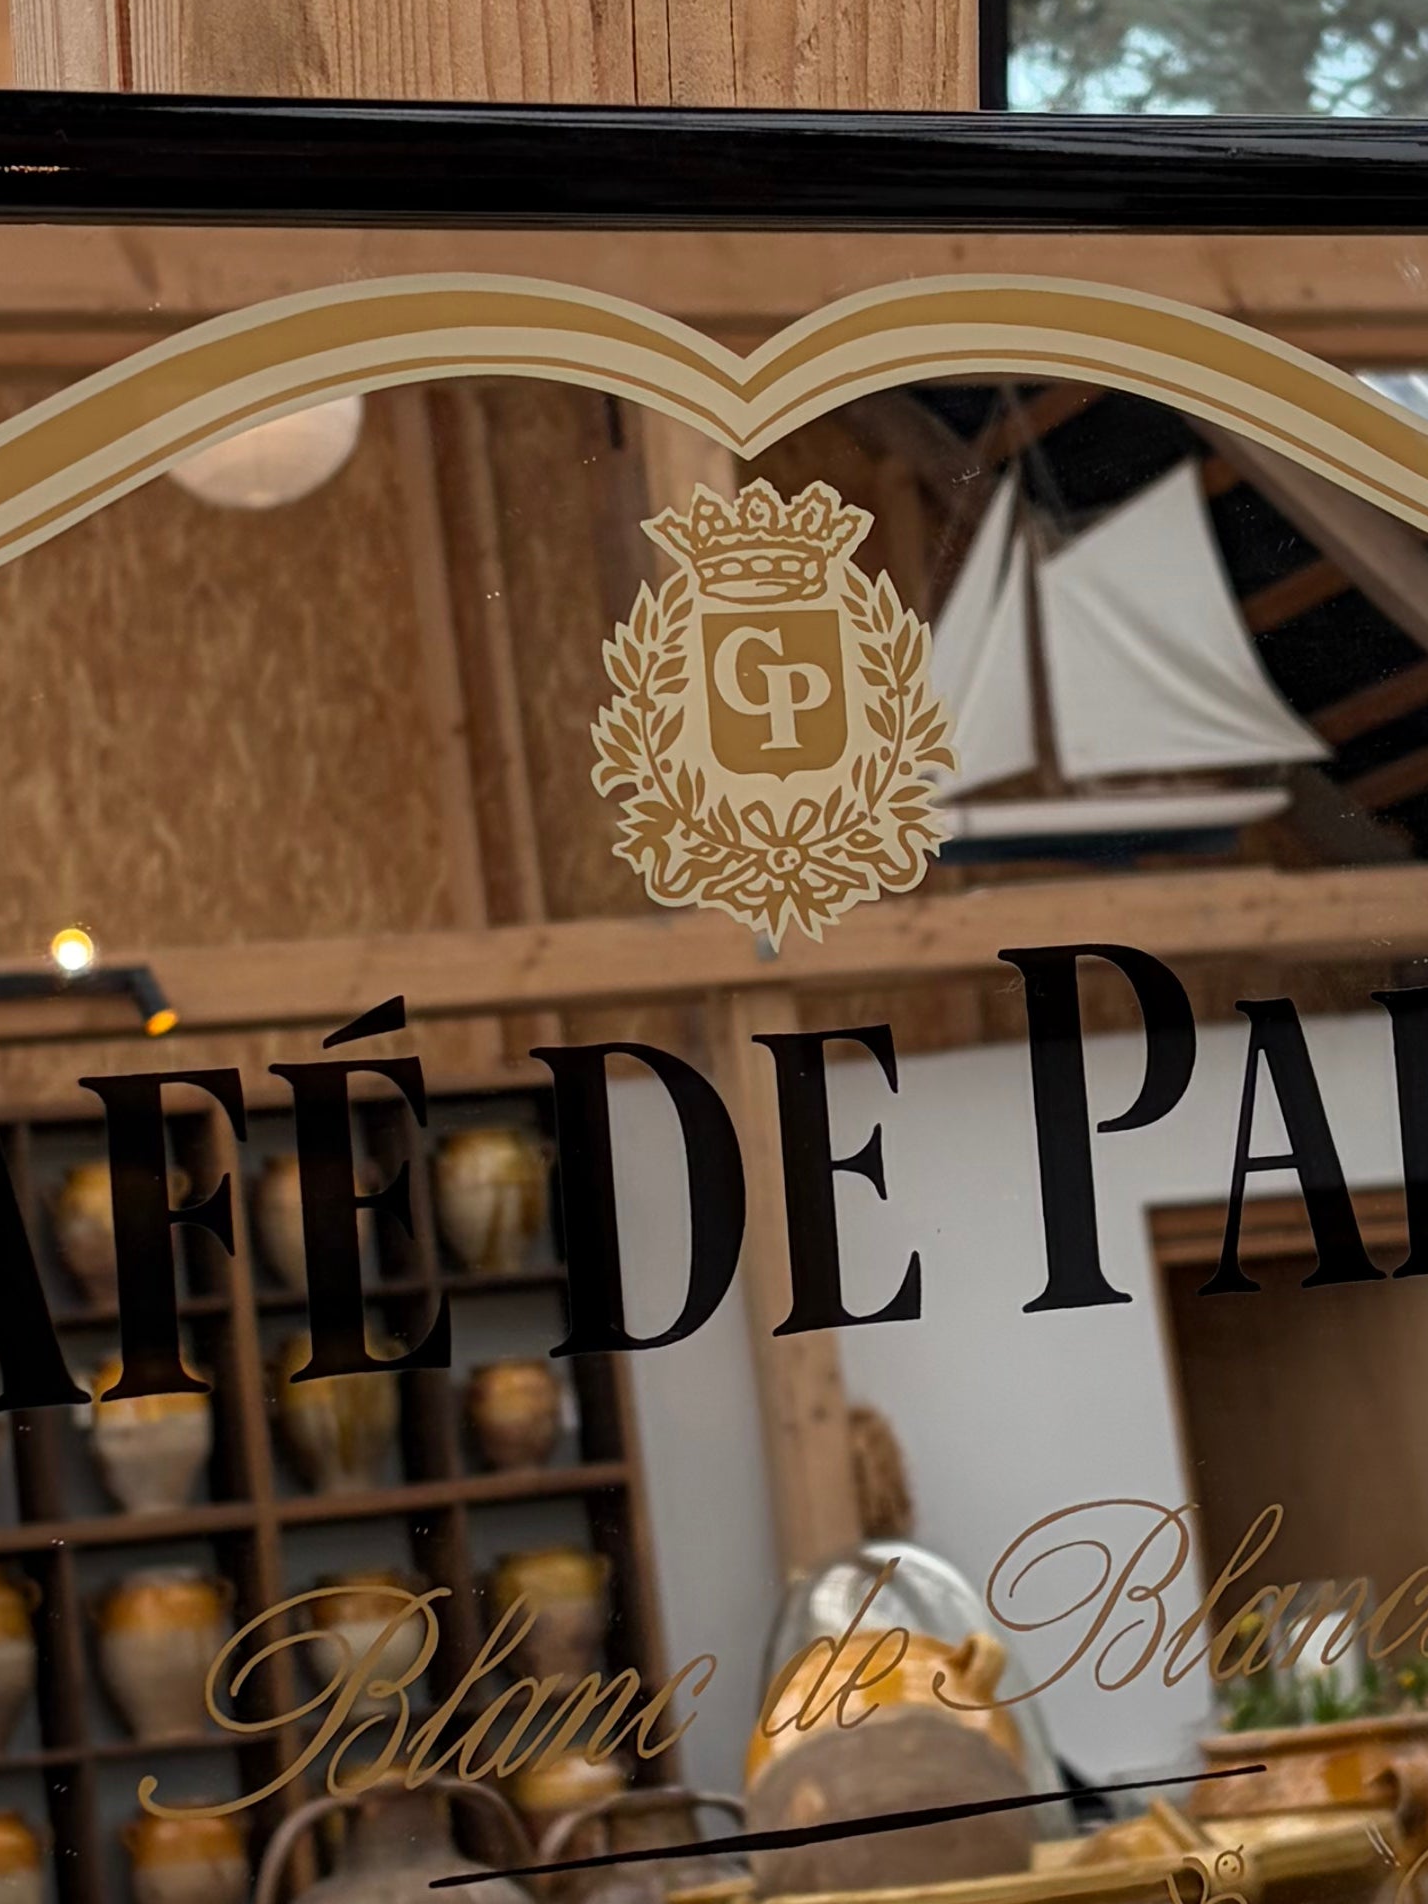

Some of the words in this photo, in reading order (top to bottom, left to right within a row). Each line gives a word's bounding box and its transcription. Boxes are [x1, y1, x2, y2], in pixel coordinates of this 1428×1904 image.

[529, 1023, 924, 1360] DE
[138, 1585, 718, 1820] Blanc
[760, 1556, 910, 1740] de
